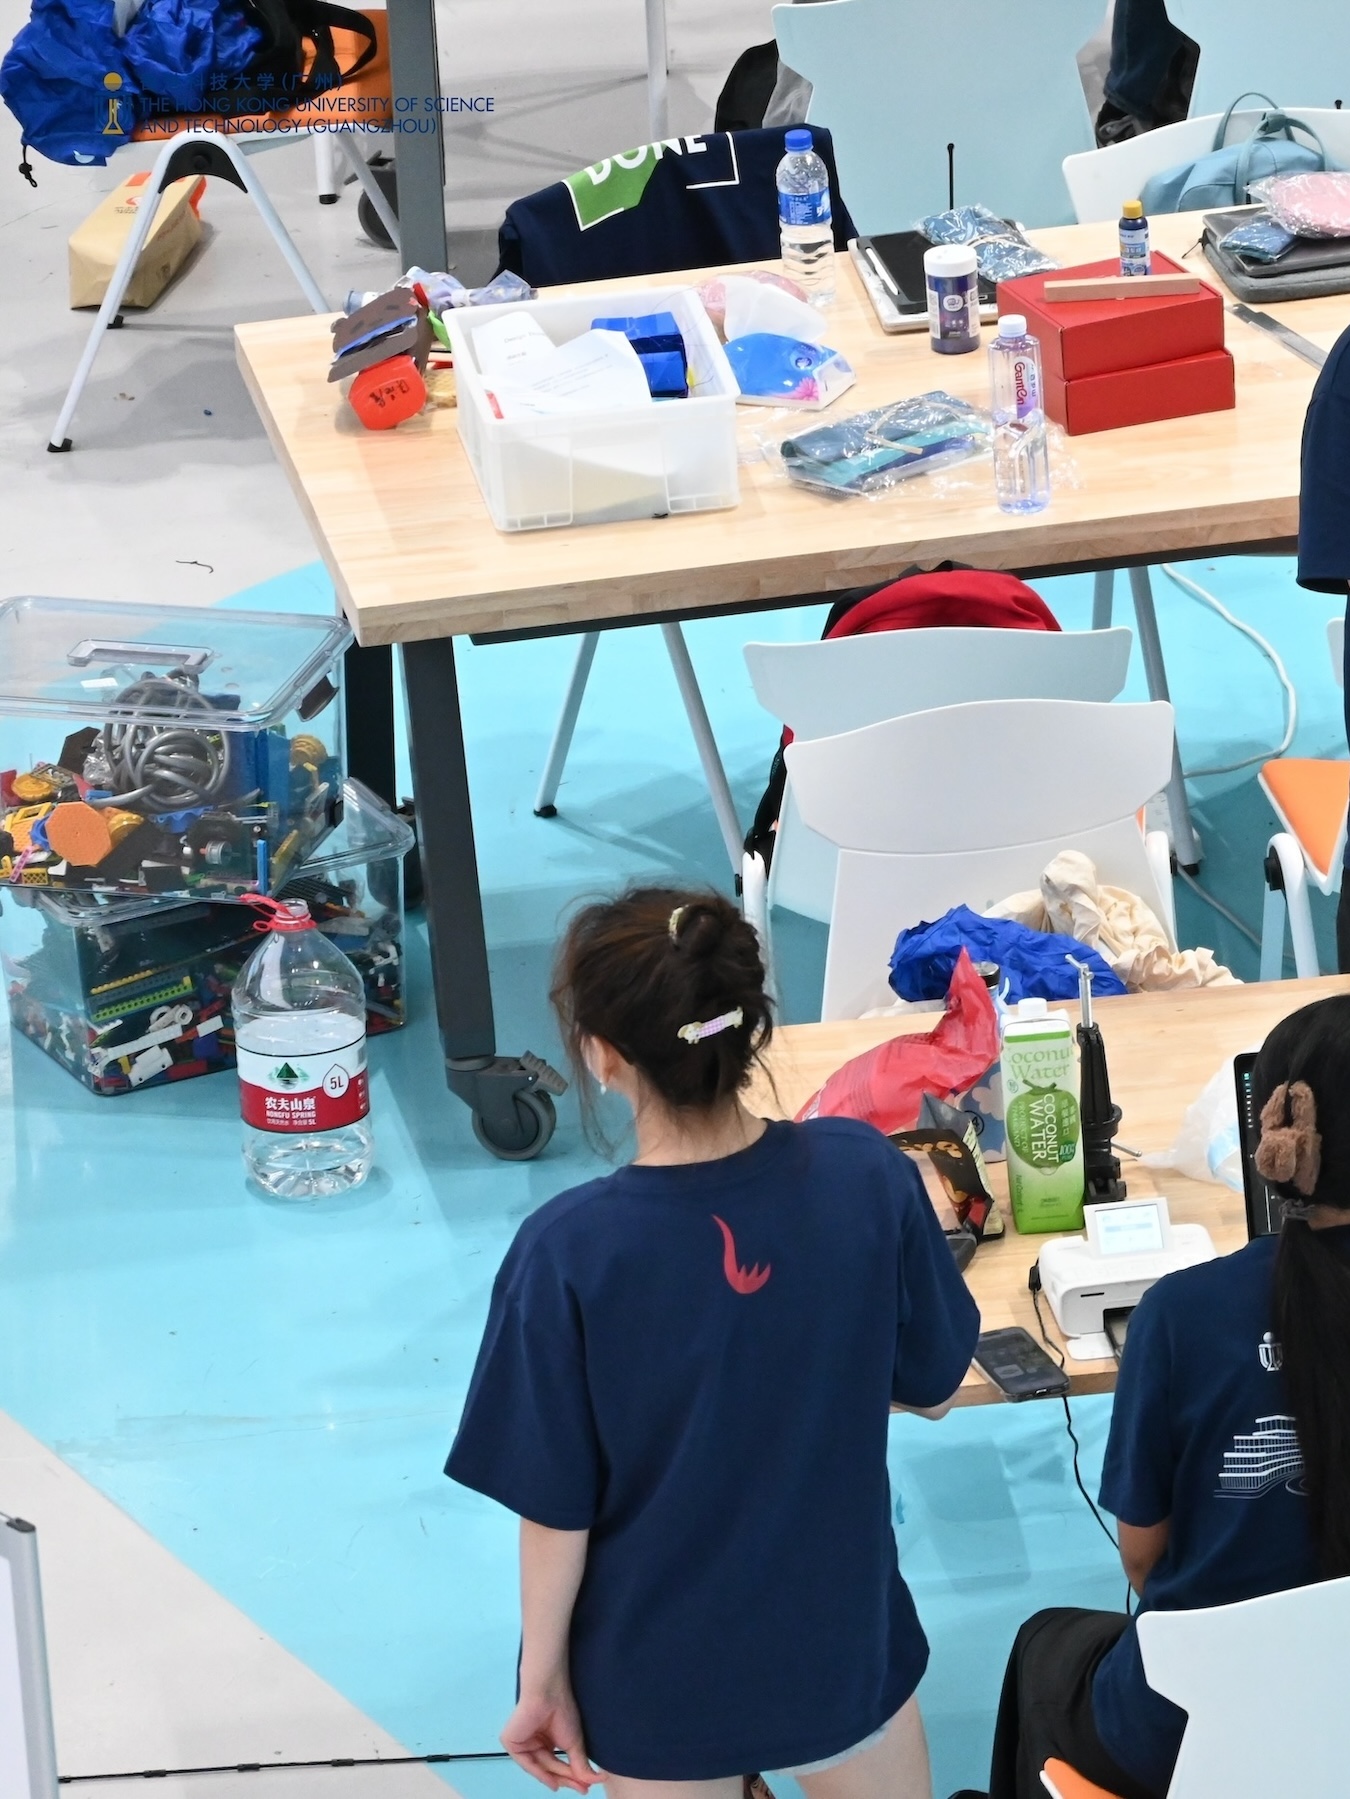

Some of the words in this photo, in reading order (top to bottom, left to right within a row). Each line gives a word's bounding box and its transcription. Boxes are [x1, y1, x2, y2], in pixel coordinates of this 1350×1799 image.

[1010, 1063, 1070, 1080] Water
[330, 1075, 344, 1090] 5L
[265, 1096, 316, 1111] 农夫山泉
[266, 1110, 291, 1119] NONGFU
[291, 1110, 317, 1119] SPRING
[1028, 1098, 1048, 1161] WATER
[1043, 1093, 1060, 1163] COCONUT
